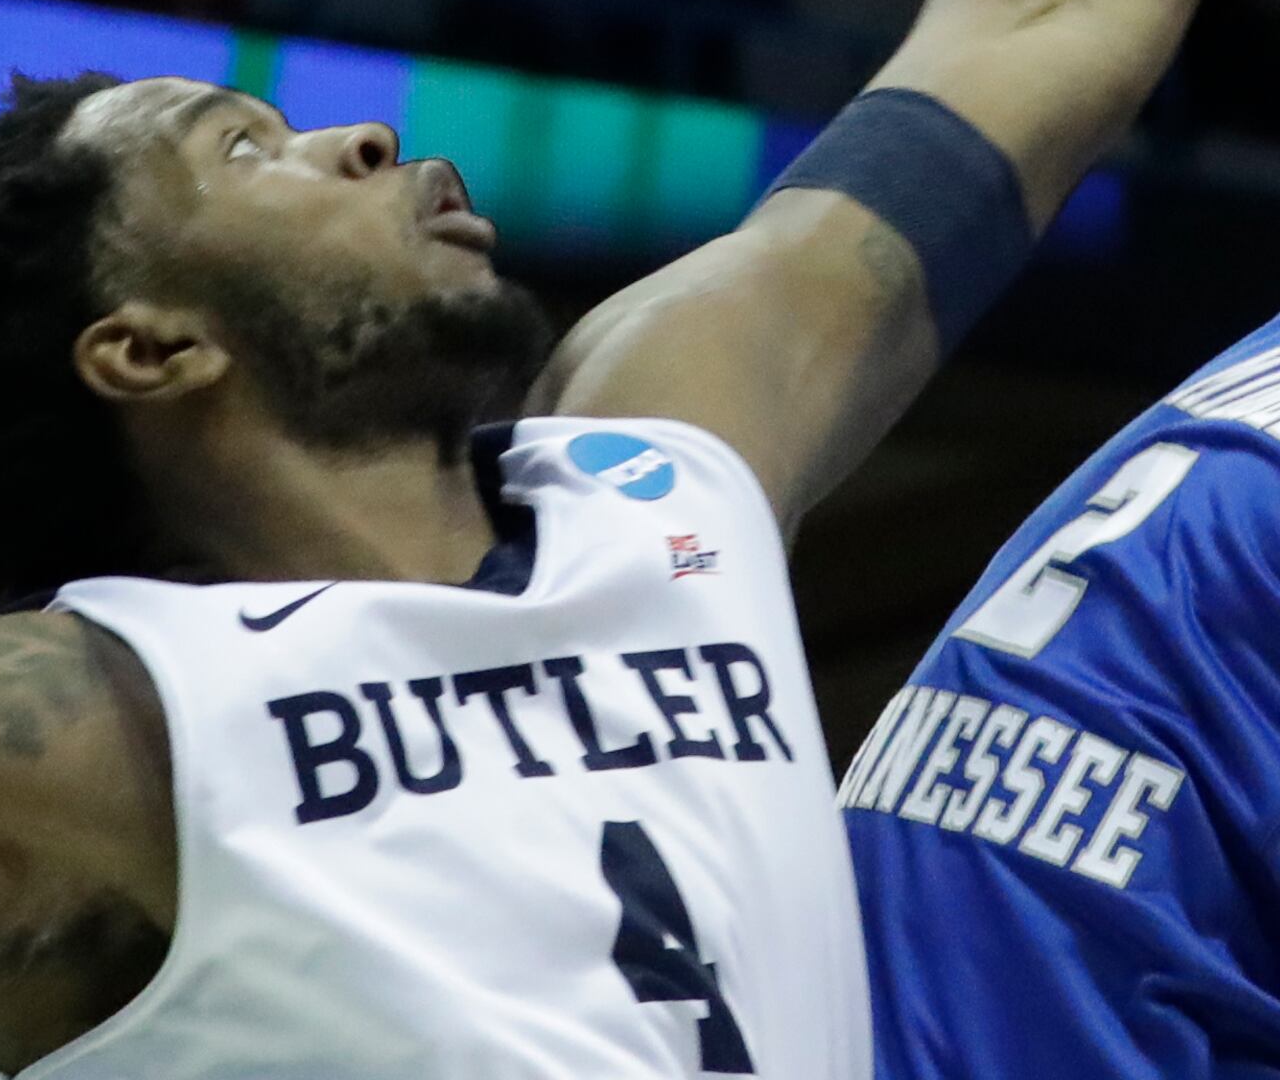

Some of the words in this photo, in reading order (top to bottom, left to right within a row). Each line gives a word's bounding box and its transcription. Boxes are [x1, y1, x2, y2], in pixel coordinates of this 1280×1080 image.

[950, 440, 1200, 660] 2
[266, 642, 795, 824] BUTLER
[834, 683, 1188, 890] NNESSEE
[599, 820, 755, 1075] 4
